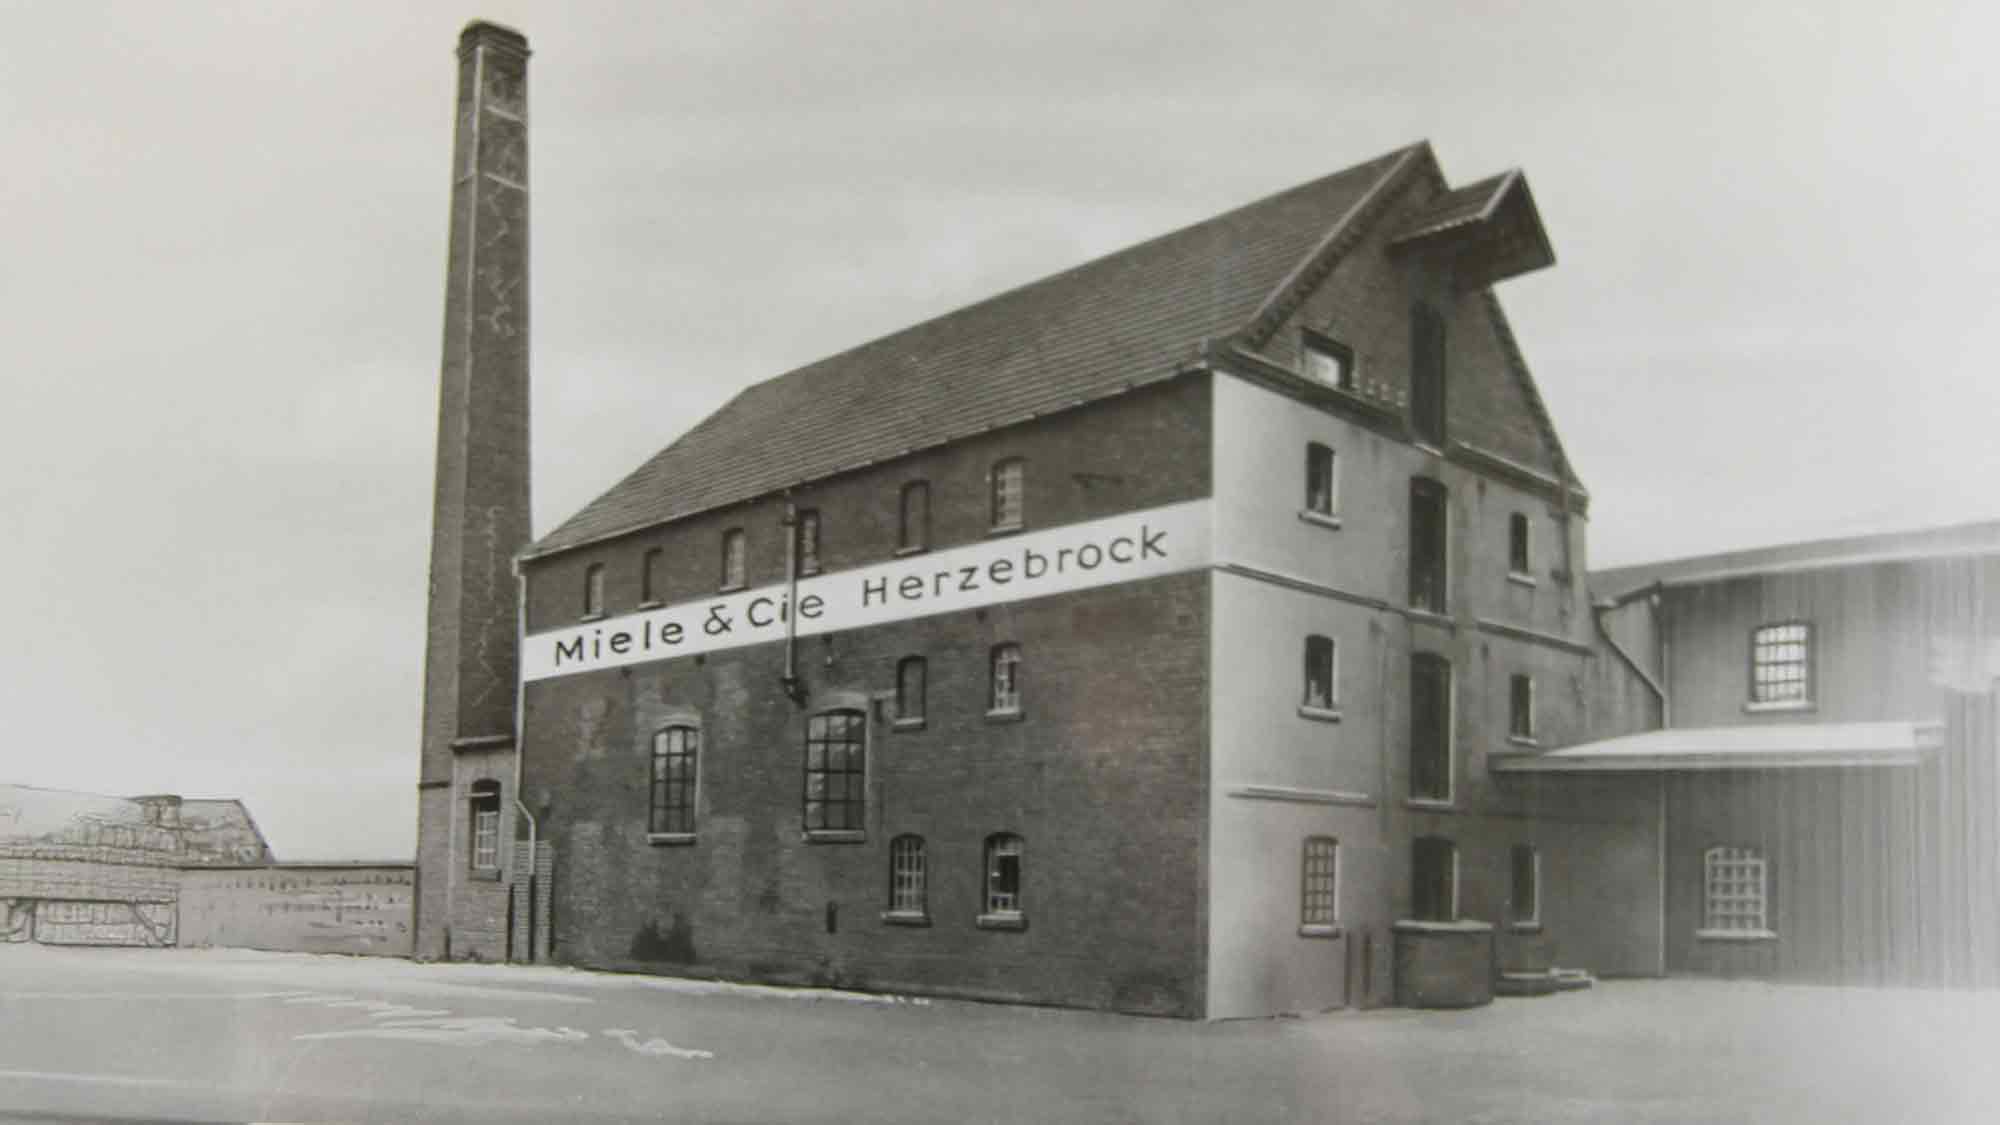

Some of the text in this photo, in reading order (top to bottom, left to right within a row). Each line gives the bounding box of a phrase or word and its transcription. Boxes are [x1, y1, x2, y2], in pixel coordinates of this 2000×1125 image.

[555, 524, 1168, 666] Miele & Cie Herzebrock
